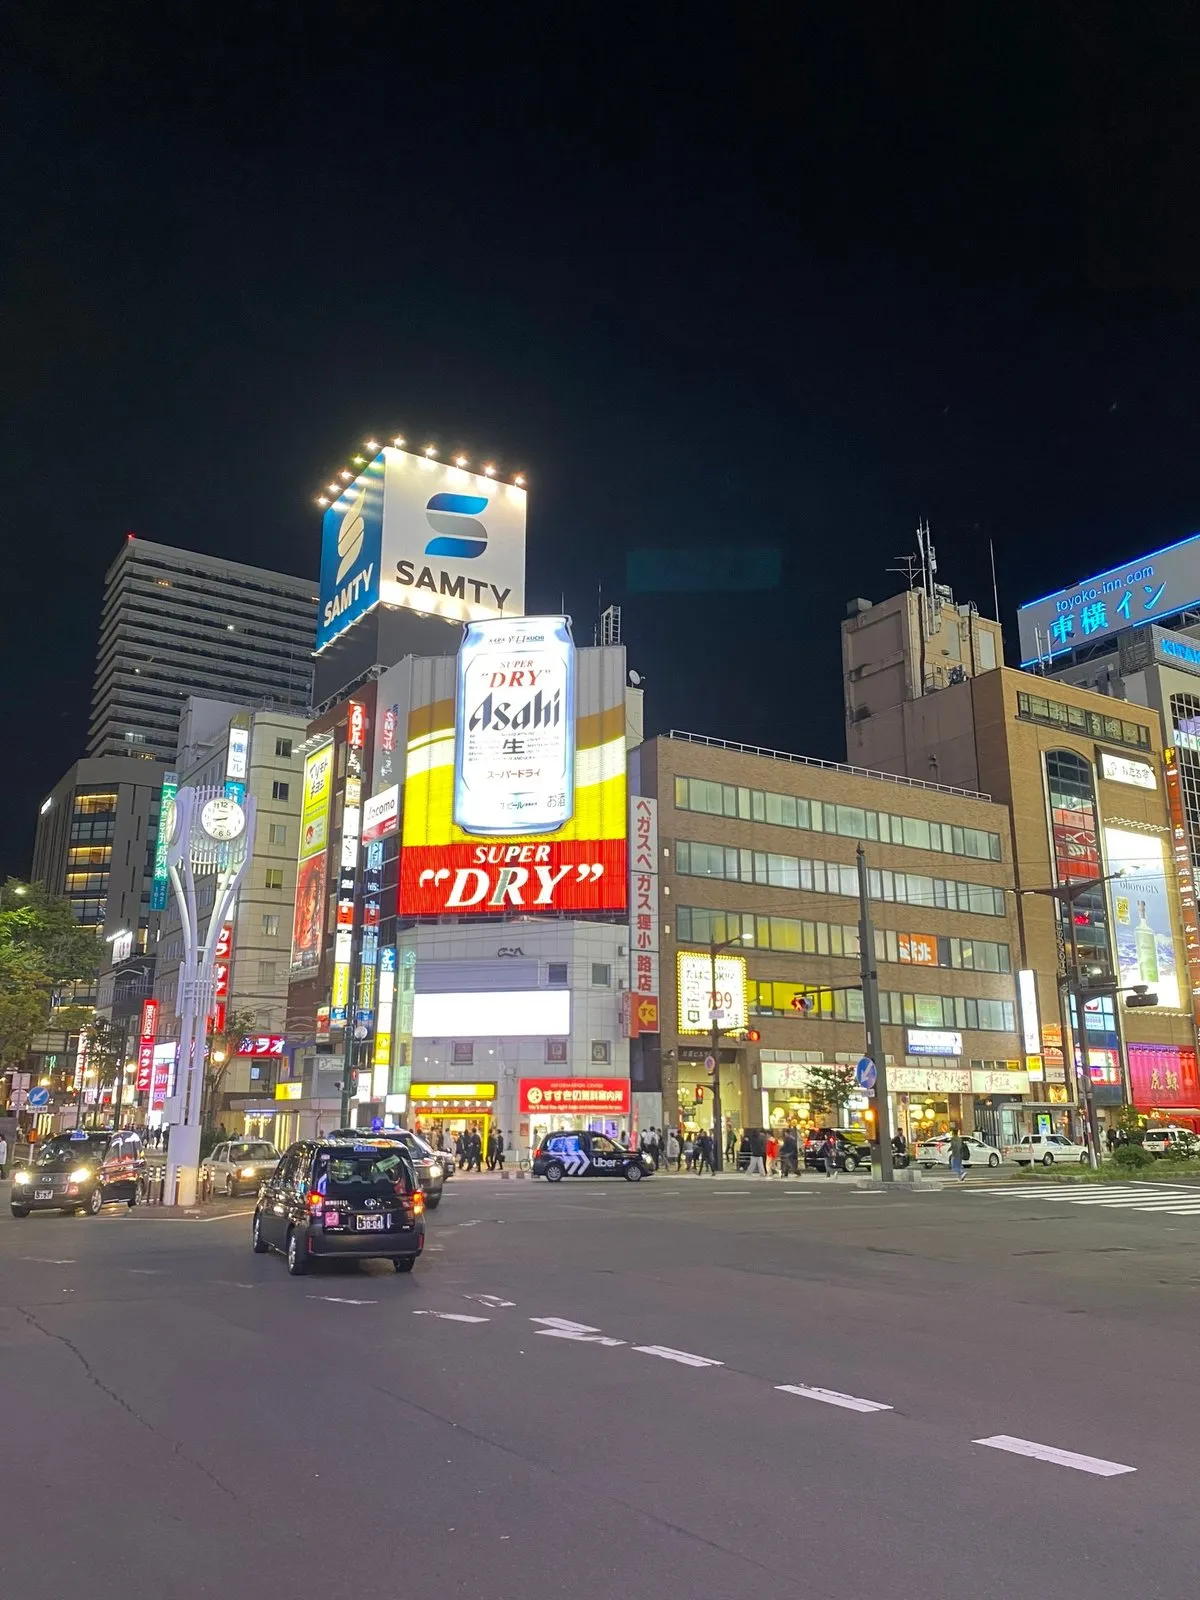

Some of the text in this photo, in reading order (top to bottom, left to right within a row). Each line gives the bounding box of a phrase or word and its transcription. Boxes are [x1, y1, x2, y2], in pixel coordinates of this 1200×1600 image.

[323, 563, 374, 628] SAMTY
[396, 560, 511, 610] SAMTY
[1056, 565, 1153, 612] toyoko-inn.com
[1050, 581, 1166, 644] 東横イン
[500, 660, 534, 668] SUPER
[469, 688, 560, 731] Asahi
[502, 738, 524, 754] 生
[487, 768, 540, 778] スーパードライ
[473, 845, 551, 864] SUPER
[636, 800, 652, 992] ベガスベガス狸小路店
[640, 1008, 654, 1017] すぐ
[593, 1158, 616, 1167] Uber
